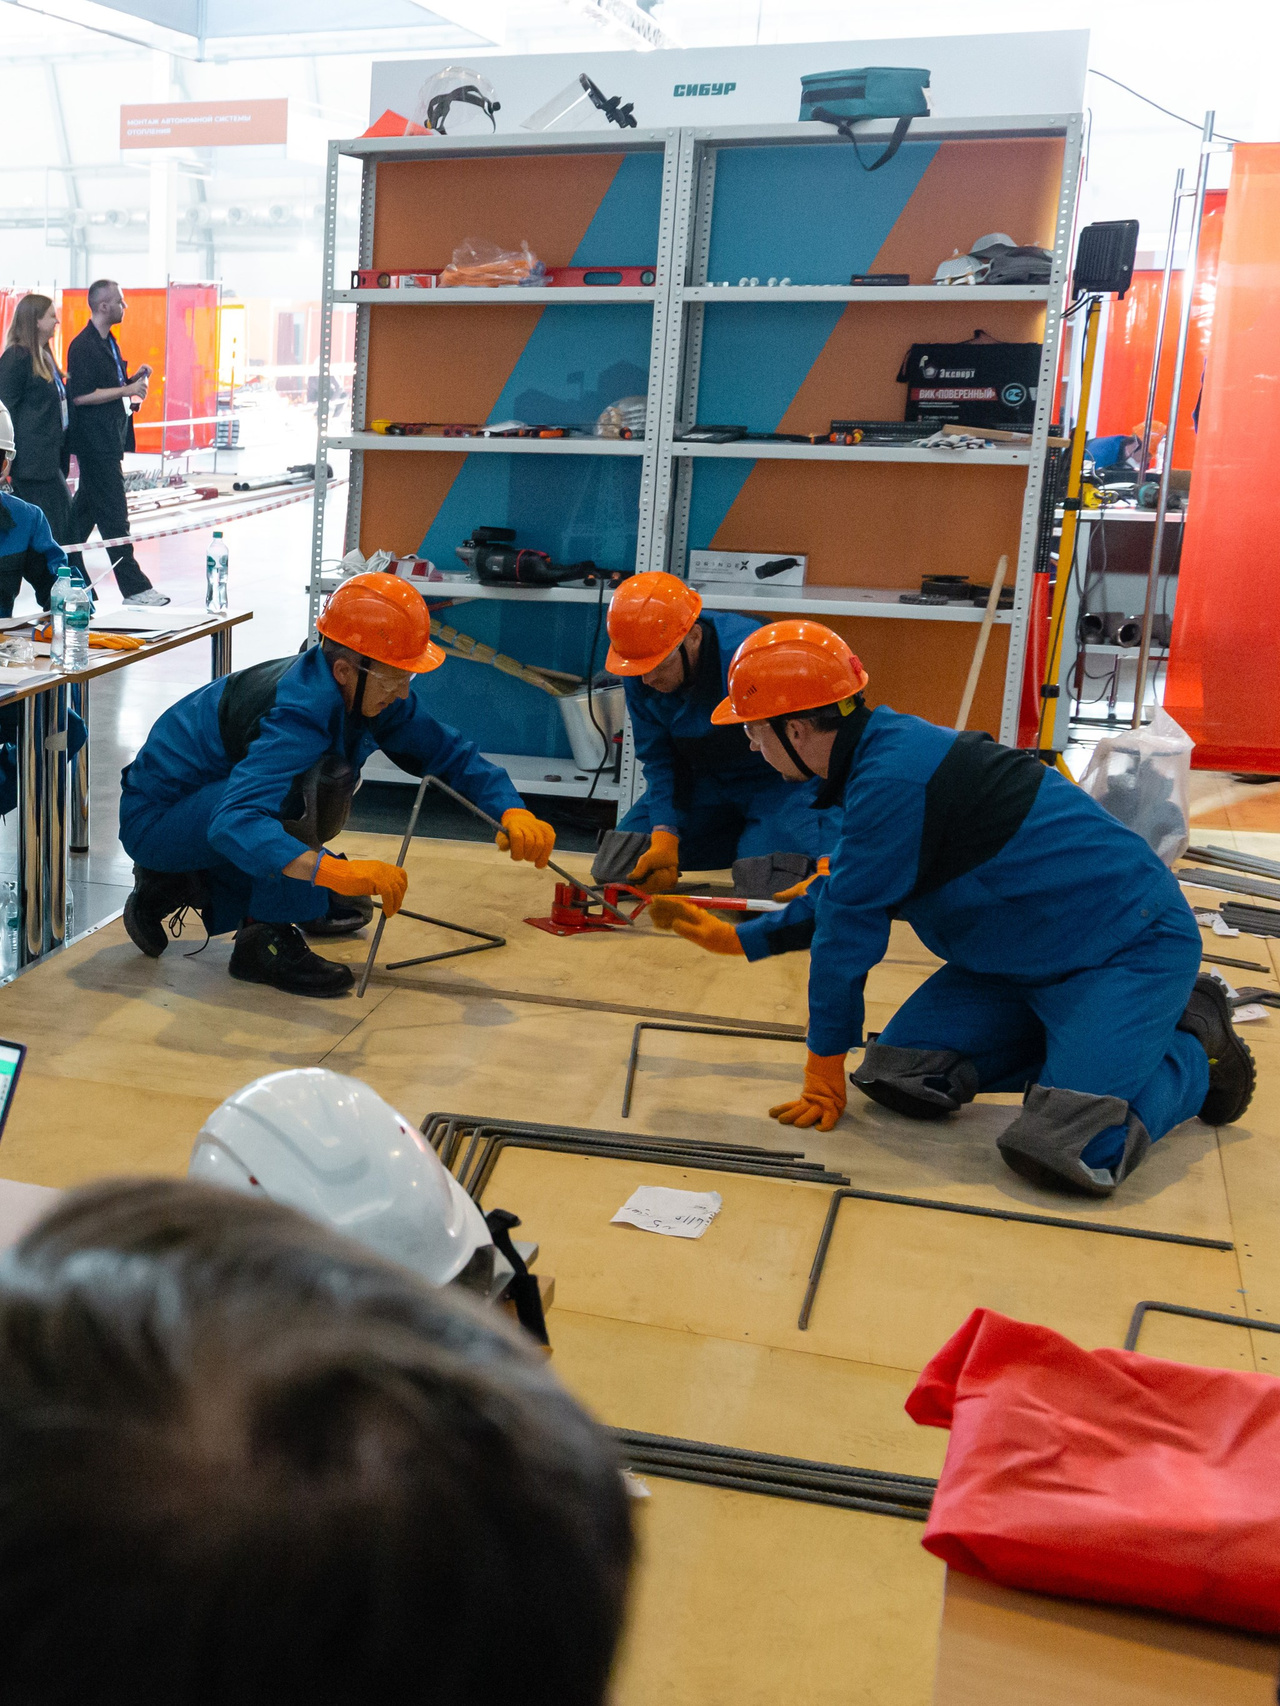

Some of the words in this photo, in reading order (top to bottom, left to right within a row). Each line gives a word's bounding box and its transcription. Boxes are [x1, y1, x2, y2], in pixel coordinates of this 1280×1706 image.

[673, 82, 737, 97] СИБУР
[127, 118, 159, 126] МОНТАЖ
[161, 115, 213, 125] АВТОНОМНОЙ
[214, 114, 251, 123] СИСТЕМЫ
[939, 368, 976, 379] Эксперт
